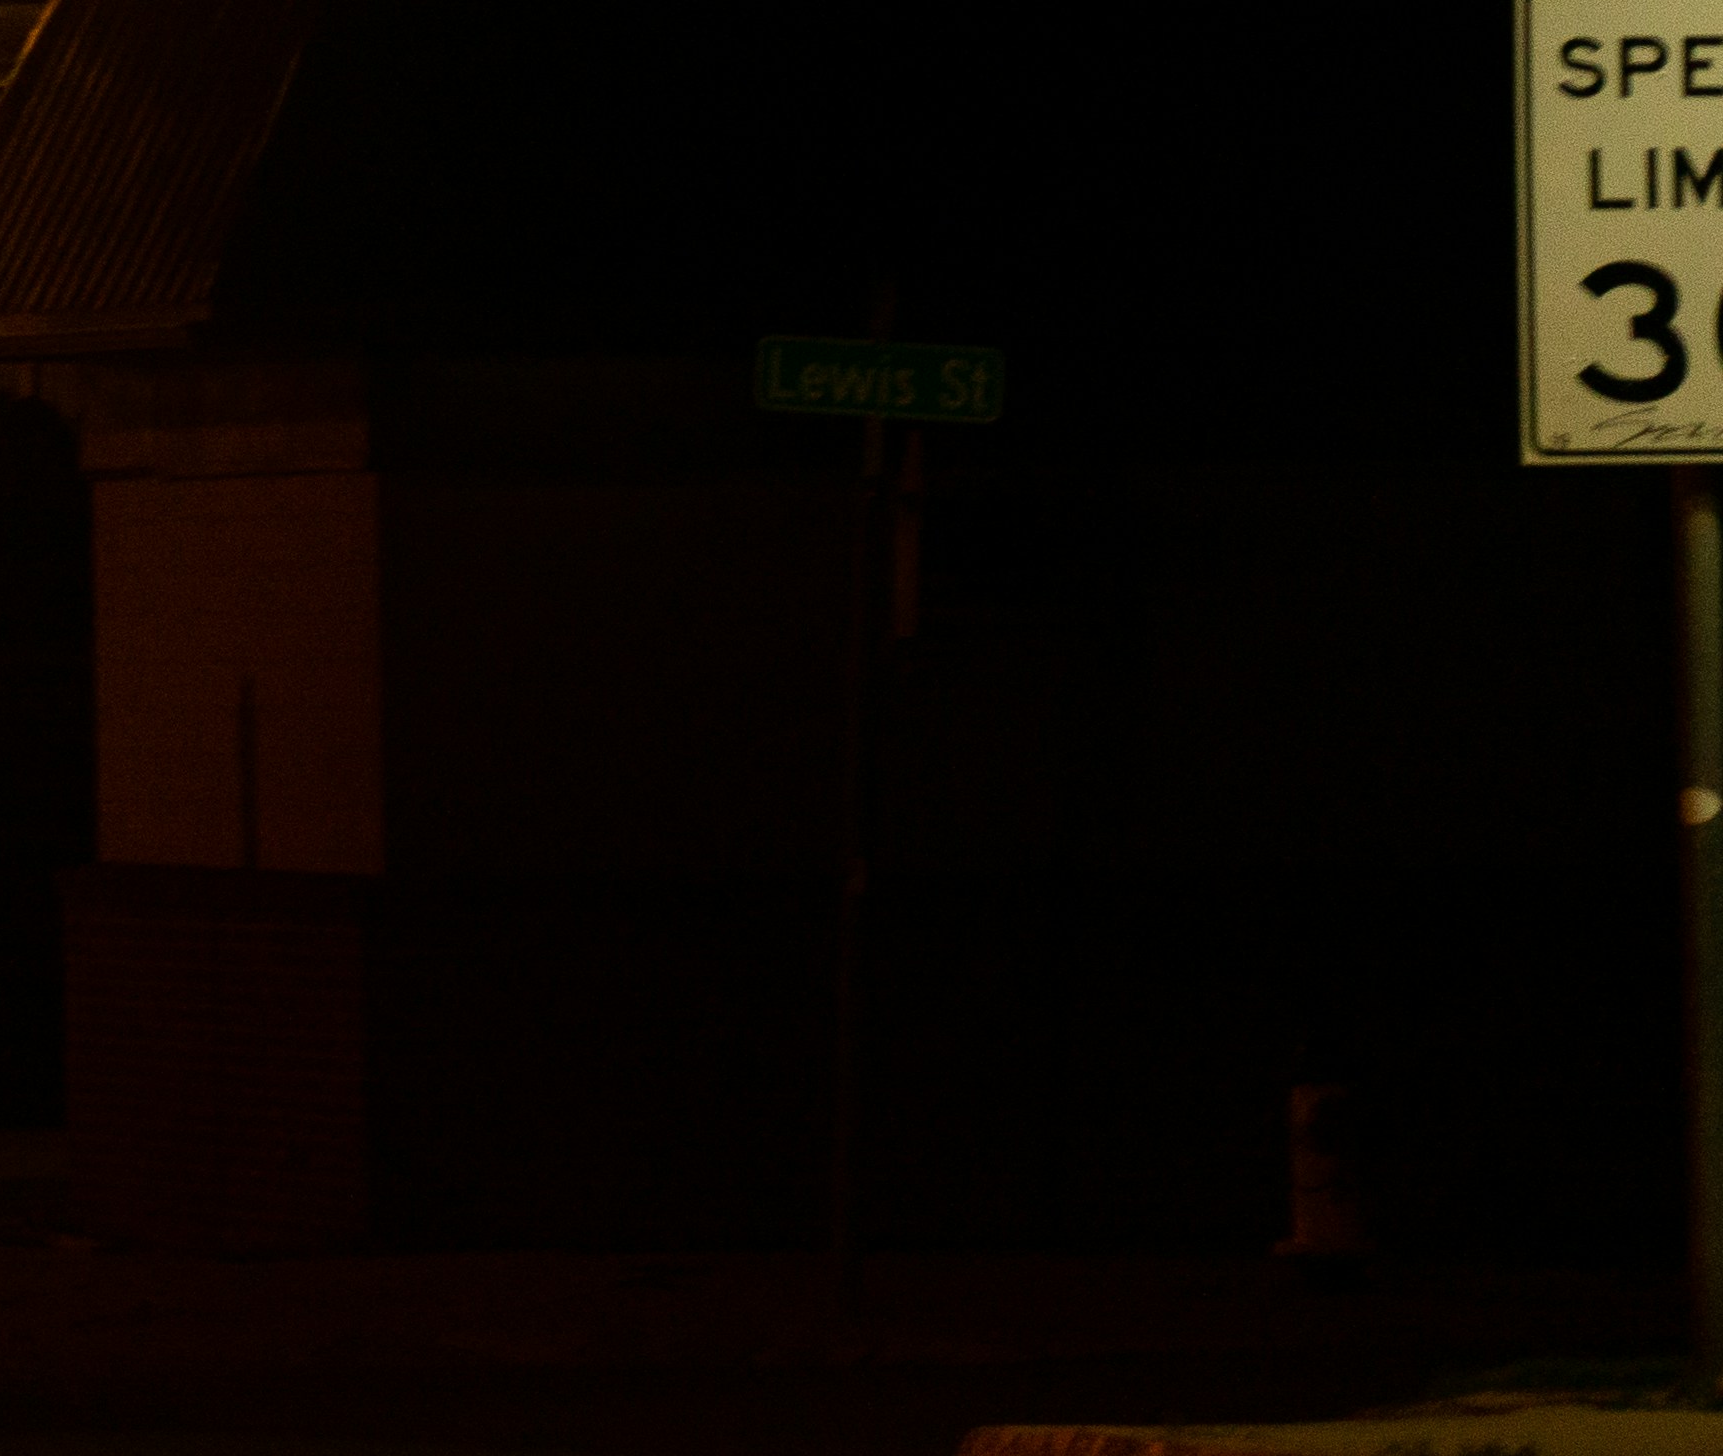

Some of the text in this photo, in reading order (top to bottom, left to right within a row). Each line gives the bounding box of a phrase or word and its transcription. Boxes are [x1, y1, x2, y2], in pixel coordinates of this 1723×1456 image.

[767, 346, 988, 415] Lewis St
[1576, 259, 1723, 405] 3
